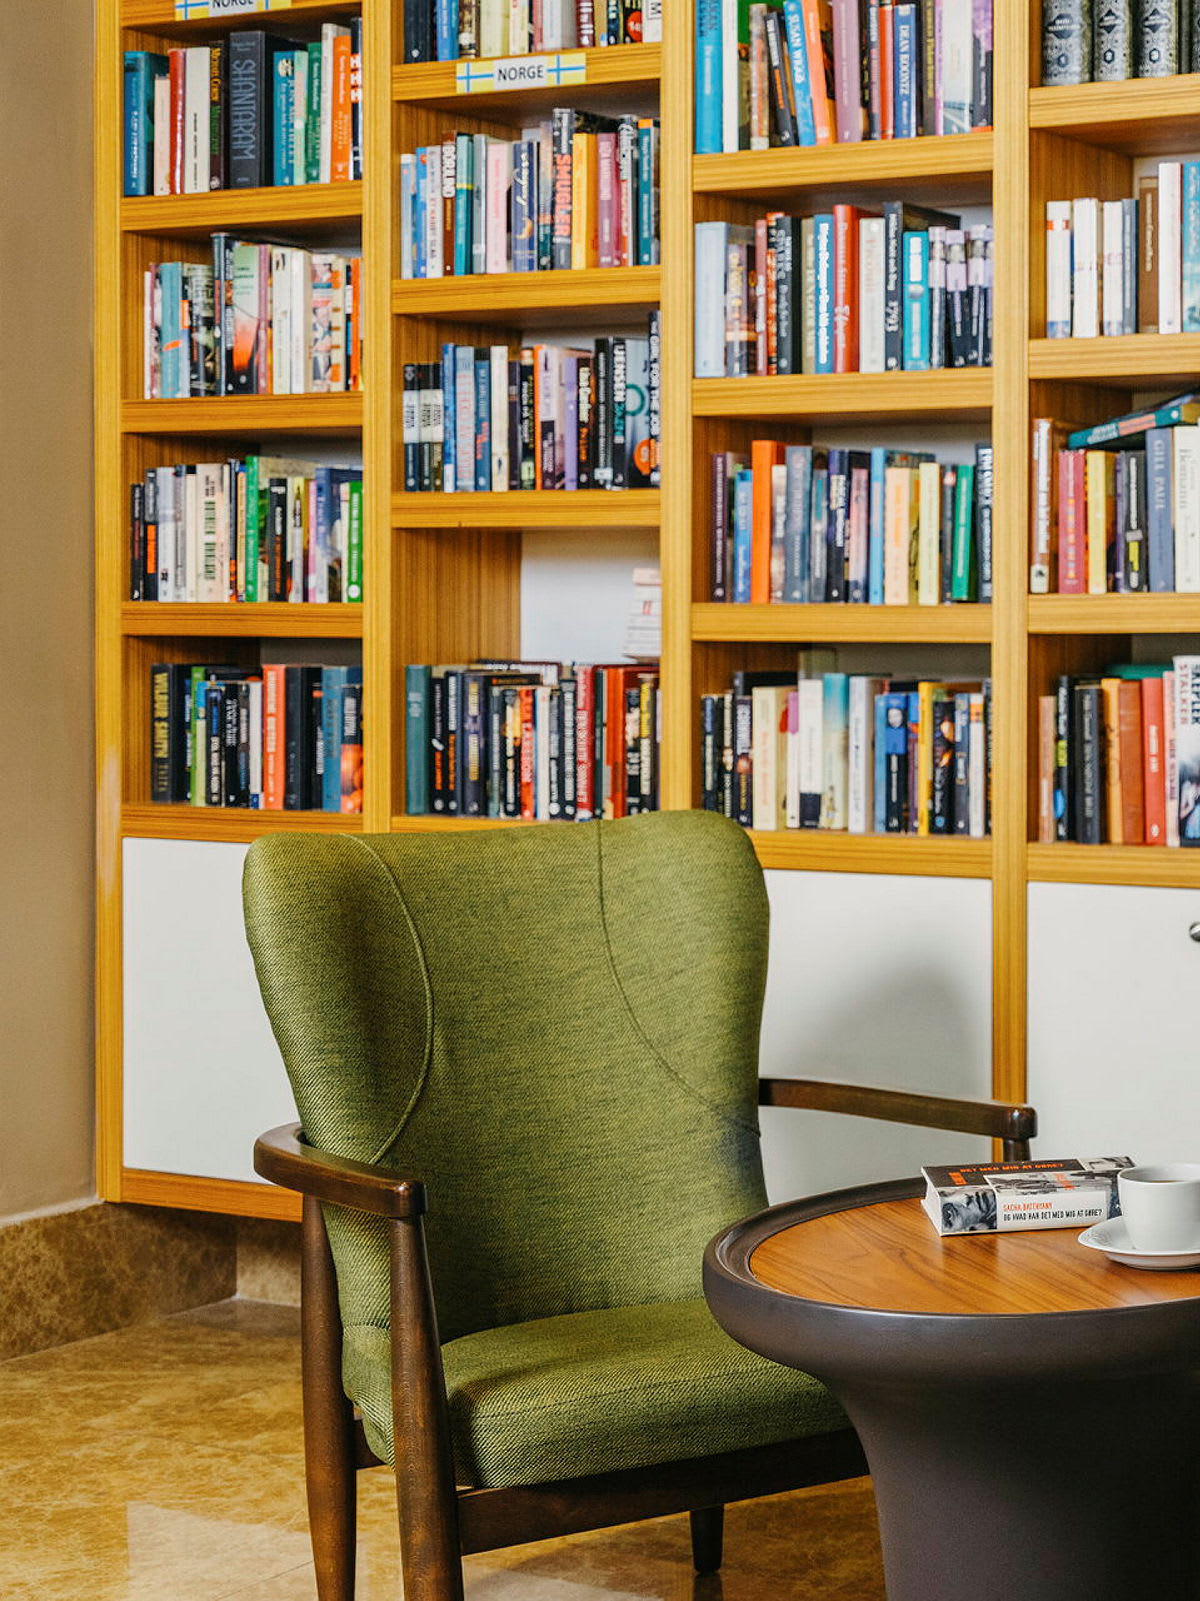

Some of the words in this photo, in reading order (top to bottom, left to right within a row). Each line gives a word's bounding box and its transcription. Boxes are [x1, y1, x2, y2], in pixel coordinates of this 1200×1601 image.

[497, 65, 544, 81] NORGE
[231, 59, 257, 160] SHANTARAM
[555, 154, 572, 237] SMUGLER
[886, 301, 898, 332] 1793
[650, 336, 660, 361] GIRL
[650, 363, 659, 387] FOR
[650, 390, 659, 412] THE
[1154, 440, 1164, 474] GILL
[1154, 477, 1164, 511] PAUL
[154, 673, 169, 718] WILBUR
[1179, 664, 1189, 725] STALKER
[154, 721, 169, 759] SMITH
[1003, 1213, 1012, 1222] OG
[1013, 1212, 1027, 1221] HVAD
[1029, 1212, 1040, 1220] HAR
[1041, 1211, 1051, 1220] DET
[1052, 1210, 1064, 1219] MED
[1065, 1210, 1076, 1219] MIG
[1077, 1210, 1085, 1218] AT
[1086, 1209, 1103, 1217] GØRE?
